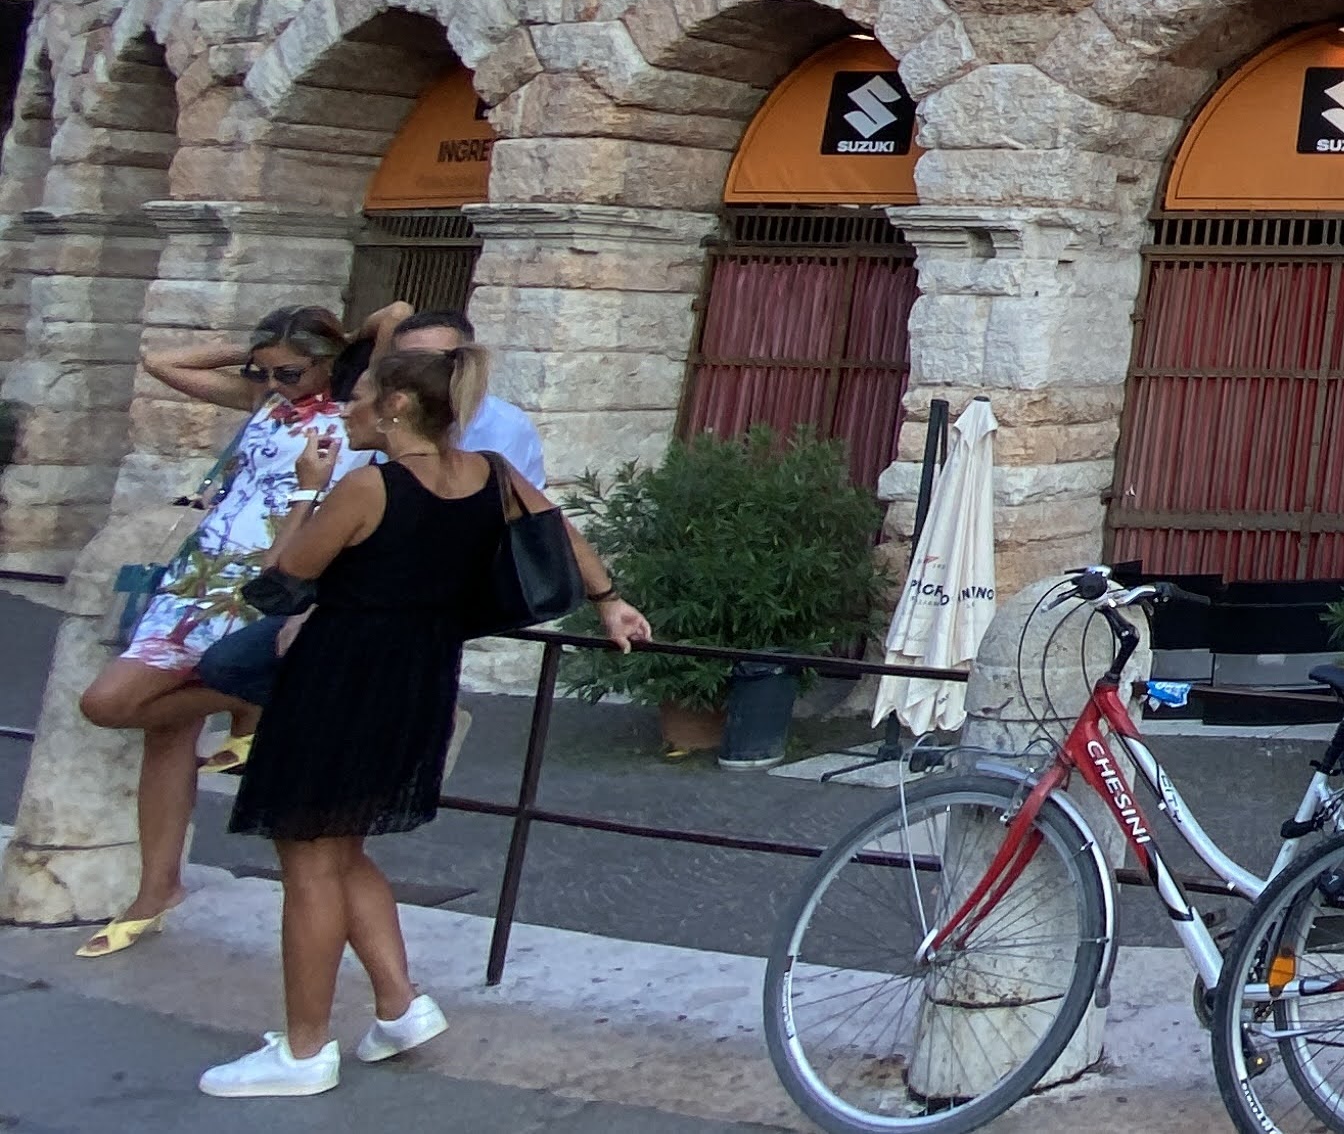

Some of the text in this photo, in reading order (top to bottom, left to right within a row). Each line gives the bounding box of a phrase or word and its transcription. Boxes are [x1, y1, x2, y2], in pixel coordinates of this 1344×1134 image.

[437, 138, 491, 163] INGRE
[837, 141, 895, 152] SUZUKI
[1087, 740, 1151, 844] CHESINI
